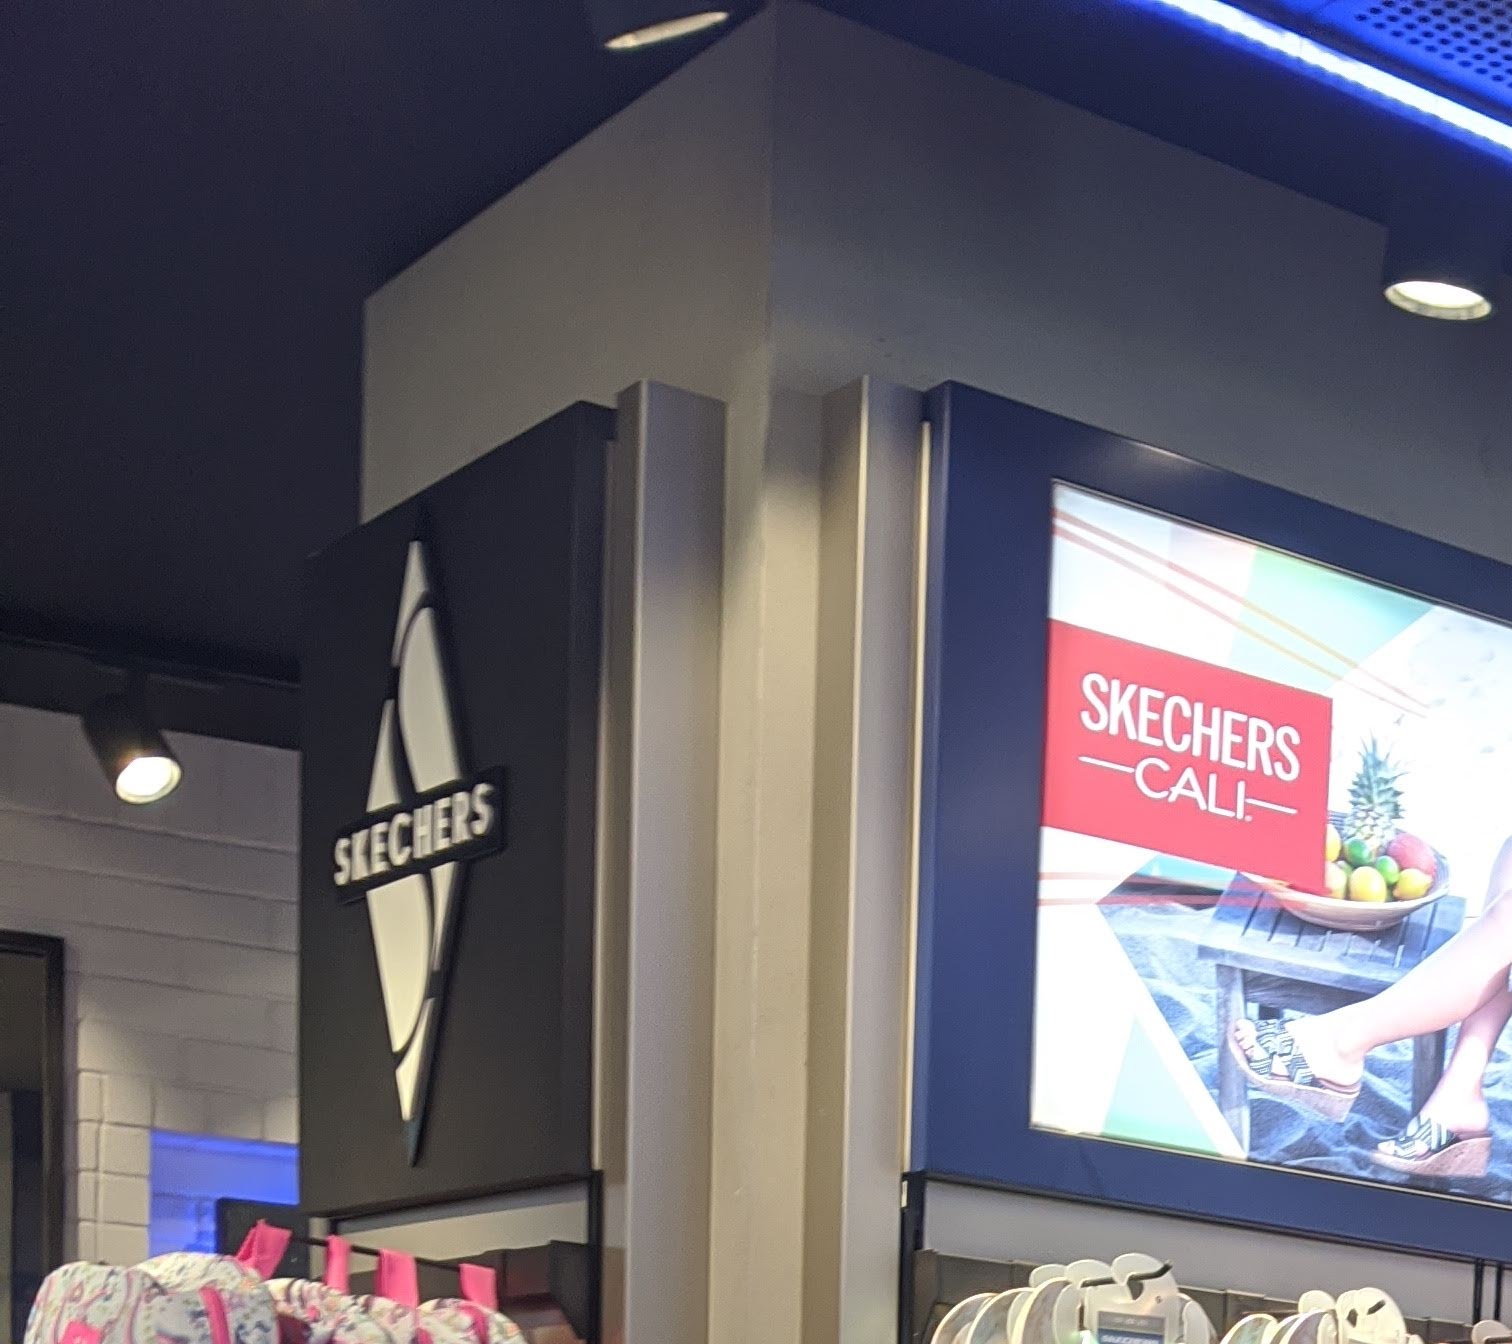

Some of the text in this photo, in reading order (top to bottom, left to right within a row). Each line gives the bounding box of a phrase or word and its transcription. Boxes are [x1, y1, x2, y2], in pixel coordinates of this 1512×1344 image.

[1080, 672, 1301, 783] SKECHERS
[333, 783, 494, 886] SKECHERS
[1133, 757, 1252, 822] CALI
